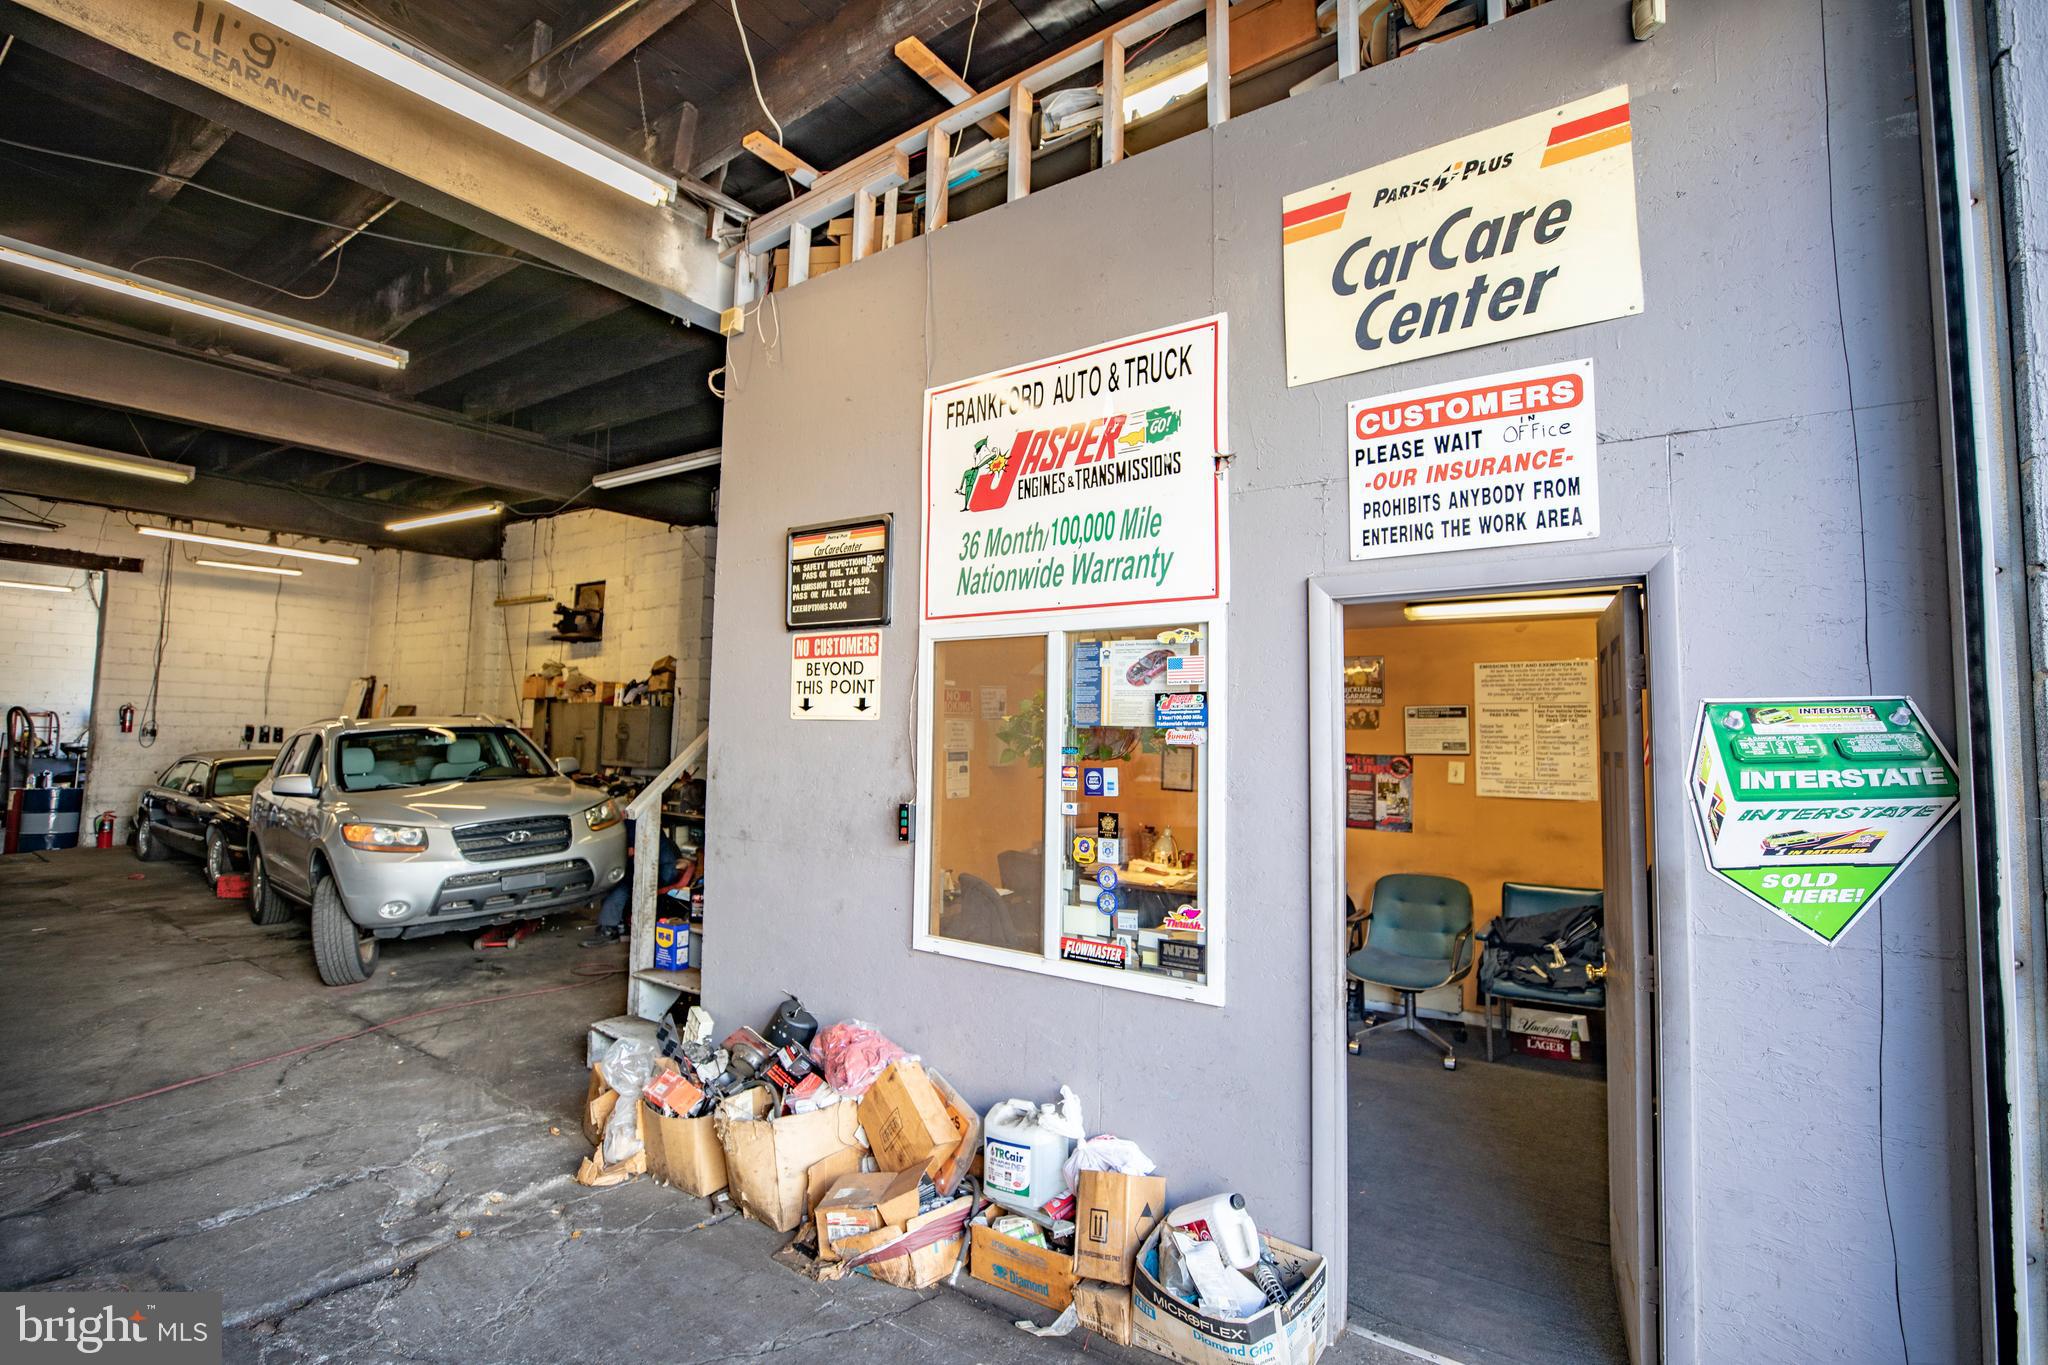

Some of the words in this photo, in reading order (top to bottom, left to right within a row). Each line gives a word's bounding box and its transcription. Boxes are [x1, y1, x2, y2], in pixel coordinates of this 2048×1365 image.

[173, 31, 331, 117] CLEARANCE
[1331, 199, 1572, 296] CarCare
[1354, 265, 1560, 351] Center
[946, 382, 1044, 429] FRANKFORD
[1053, 366, 1101, 405] AUTO
[1108, 362, 1120, 392] &
[1124, 345, 1193, 388] TRUCK
[1359, 380, 1575, 434] CUSTOMERS
[1150, 416, 1171, 434] GO!
[1520, 414, 1535, 424] IN
[1355, 438, 1424, 466] PLEASE
[1435, 430, 1482, 454] WAIT
[969, 414, 1127, 512] JASPER
[1018, 472, 1065, 500] ENGINES
[1067, 476, 1074, 488] &
[1075, 452, 1181, 491] TRANSMISSIONS
[1363, 493, 1441, 519] PROHIBITS
[1449, 483, 1525, 510] ANYBODY
[1533, 477, 1581, 499] FROM
[959, 529, 979, 561] 36
[1119, 505, 1162, 541] Mile
[1363, 521, 1434, 546] ENTERING
[1441, 518, 1471, 538] THE
[1479, 512, 1527, 534] WORK
[1536, 507, 1583, 529] AREA
[793, 565, 801, 573] PA
[803, 562, 825, 571] SAFETY
[802, 571, 817, 580] PASS
[819, 570, 827, 578] OR
[846, 567, 858, 575] TAX
[956, 557, 1064, 596] Nationwide
[1072, 550, 1174, 587] Warranty
[793, 584, 800, 592] PA
[801, 581, 827, 592] EMISSION
[830, 580, 846, 588] TEST
[848, 577, 869, 586] $49.99
[793, 592, 808, 601] PASS
[810, 591, 818, 599] OR
[839, 588, 851, 596] TAX
[793, 603, 828, 613] EXEMPTIONS
[829, 601, 847, 610] 30.00
[796, 638, 810, 657] NO
[814, 635, 877, 656] CUSTOMERS
[806, 661, 864, 676] BEYOND
[796, 680, 823, 695] THIS
[831, 679, 875, 694] POINT
[1740, 768, 1948, 790] INTERSTATE
[1737, 805, 1942, 821] INTERSTATE
[1762, 873, 1838, 888] SOLD
[1782, 889, 1865, 904] HERE!
[1064, 940, 1122, 961] FLOWMASTER
[1163, 943, 1199, 959] NFIB
[1527, 1039, 1565, 1053] LAGER
[1009, 1270, 1048, 1296] Diamond
[1153, 1291, 1244, 1341] MICROFLEX
[1193, 1329, 1245, 1356] Diamond
[1249, 1341, 1274, 1359] Grip
